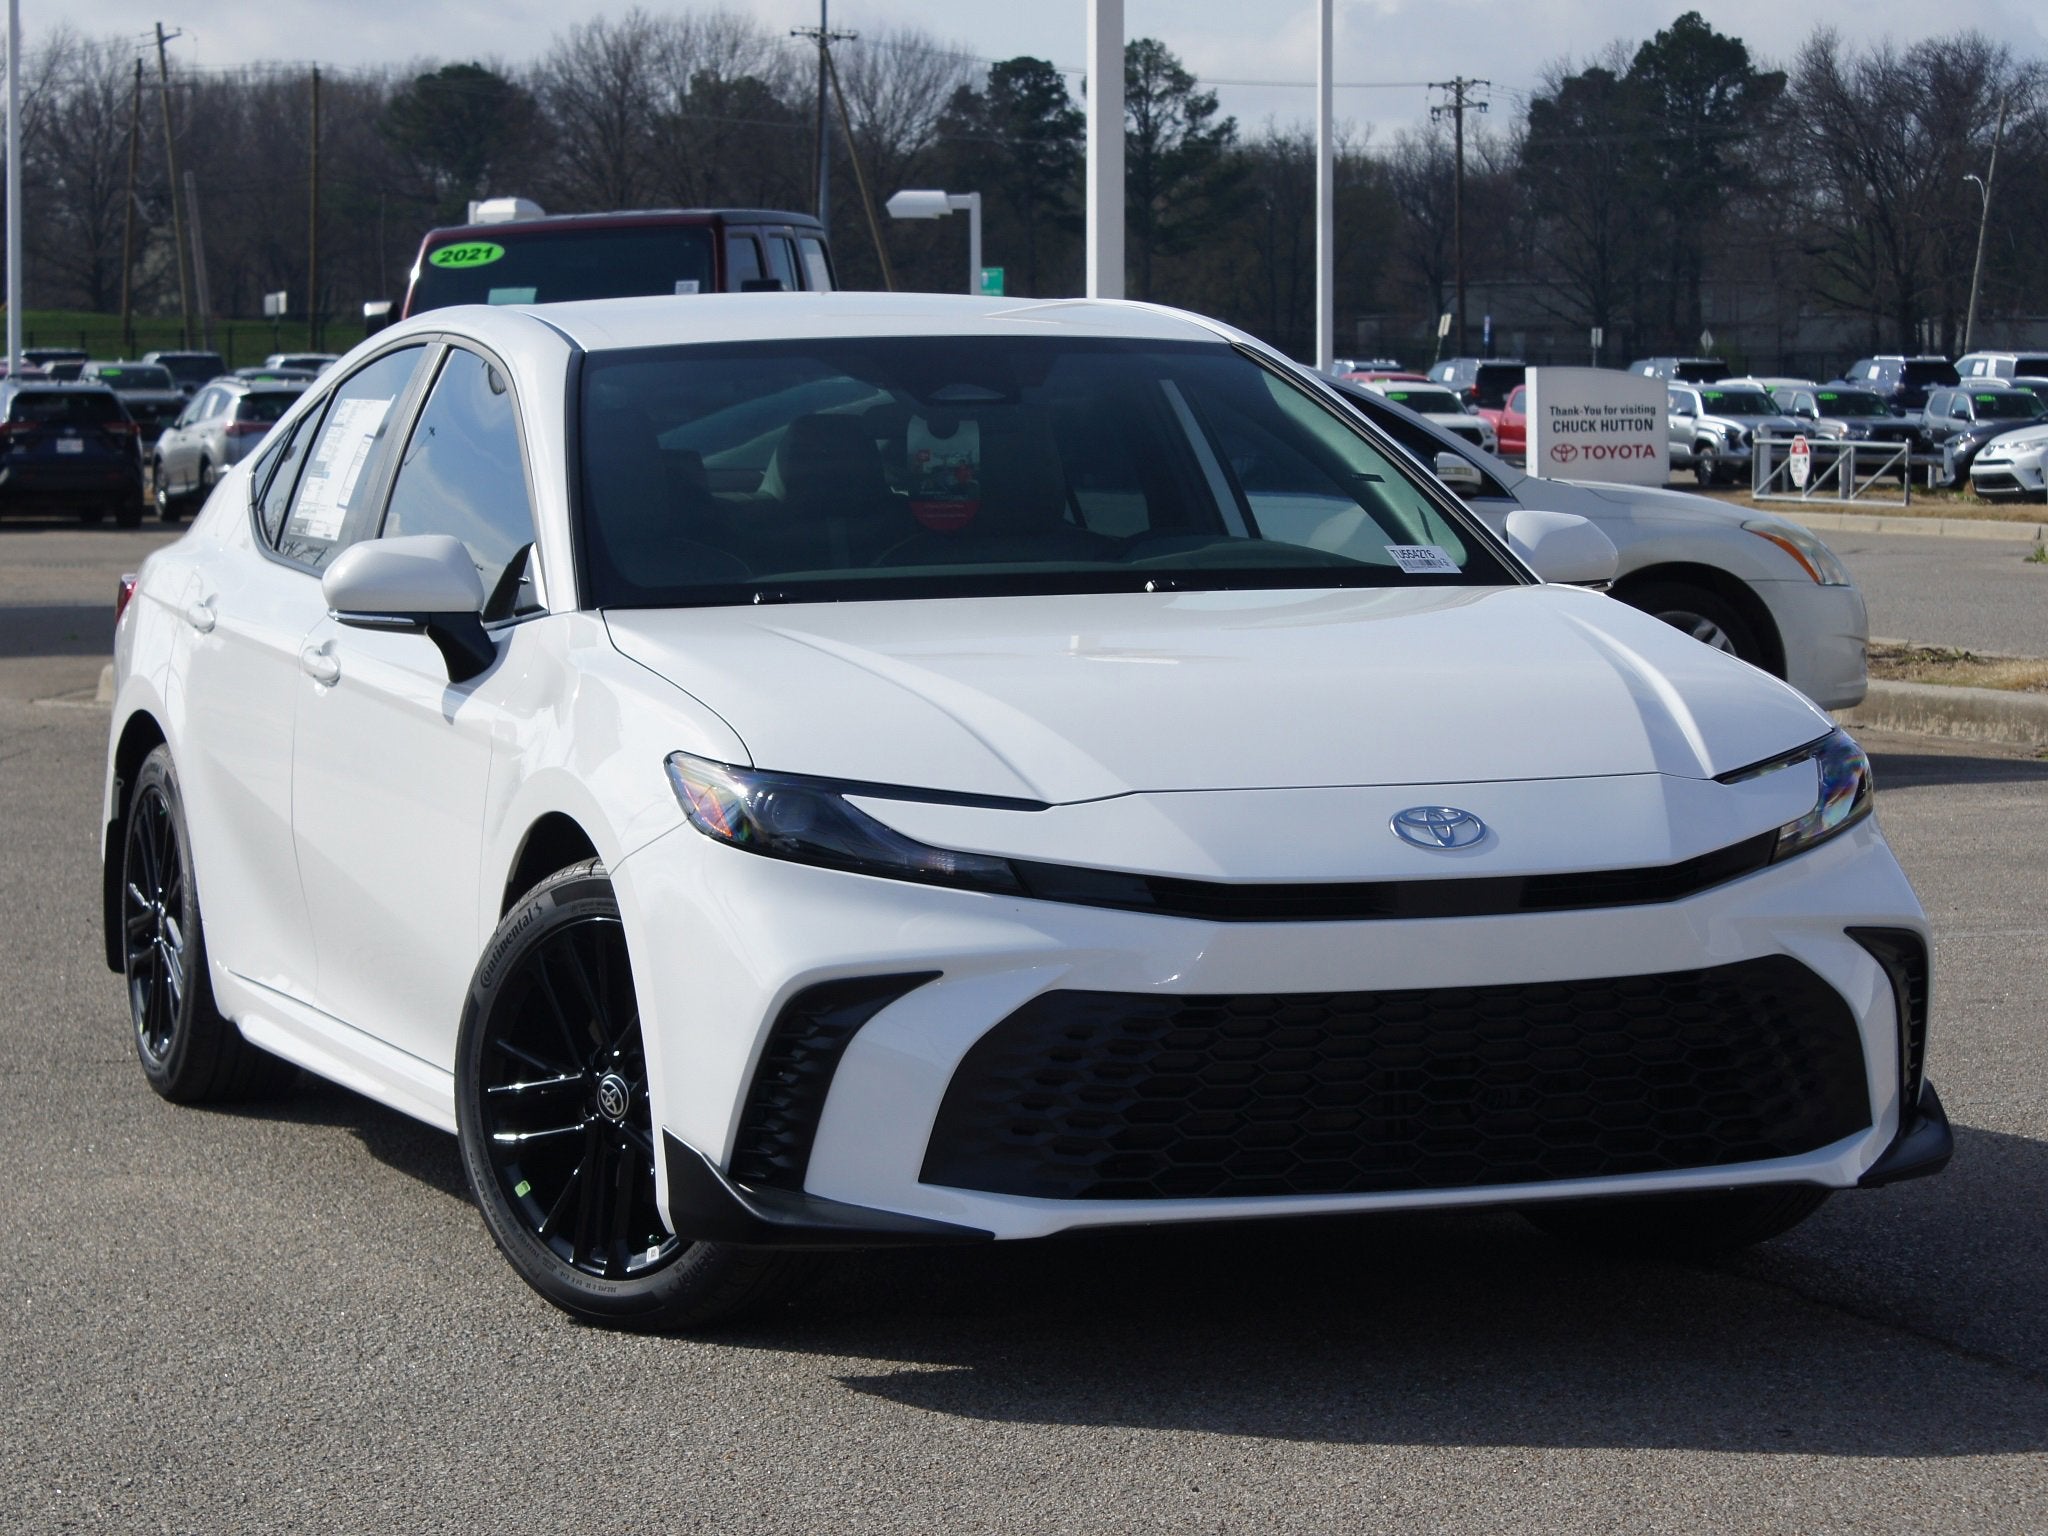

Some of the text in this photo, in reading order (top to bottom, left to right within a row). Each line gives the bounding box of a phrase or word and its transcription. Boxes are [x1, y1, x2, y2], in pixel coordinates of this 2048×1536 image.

[438, 247, 494, 264] 2021
[1604, 405, 1618, 415] for
[1620, 404, 1656, 416] visiting
[1552, 419, 1653, 433] CHUCK HUTTON
[1581, 444, 1656, 460] TOYOTA
[480, 908, 533, 988] Continental
